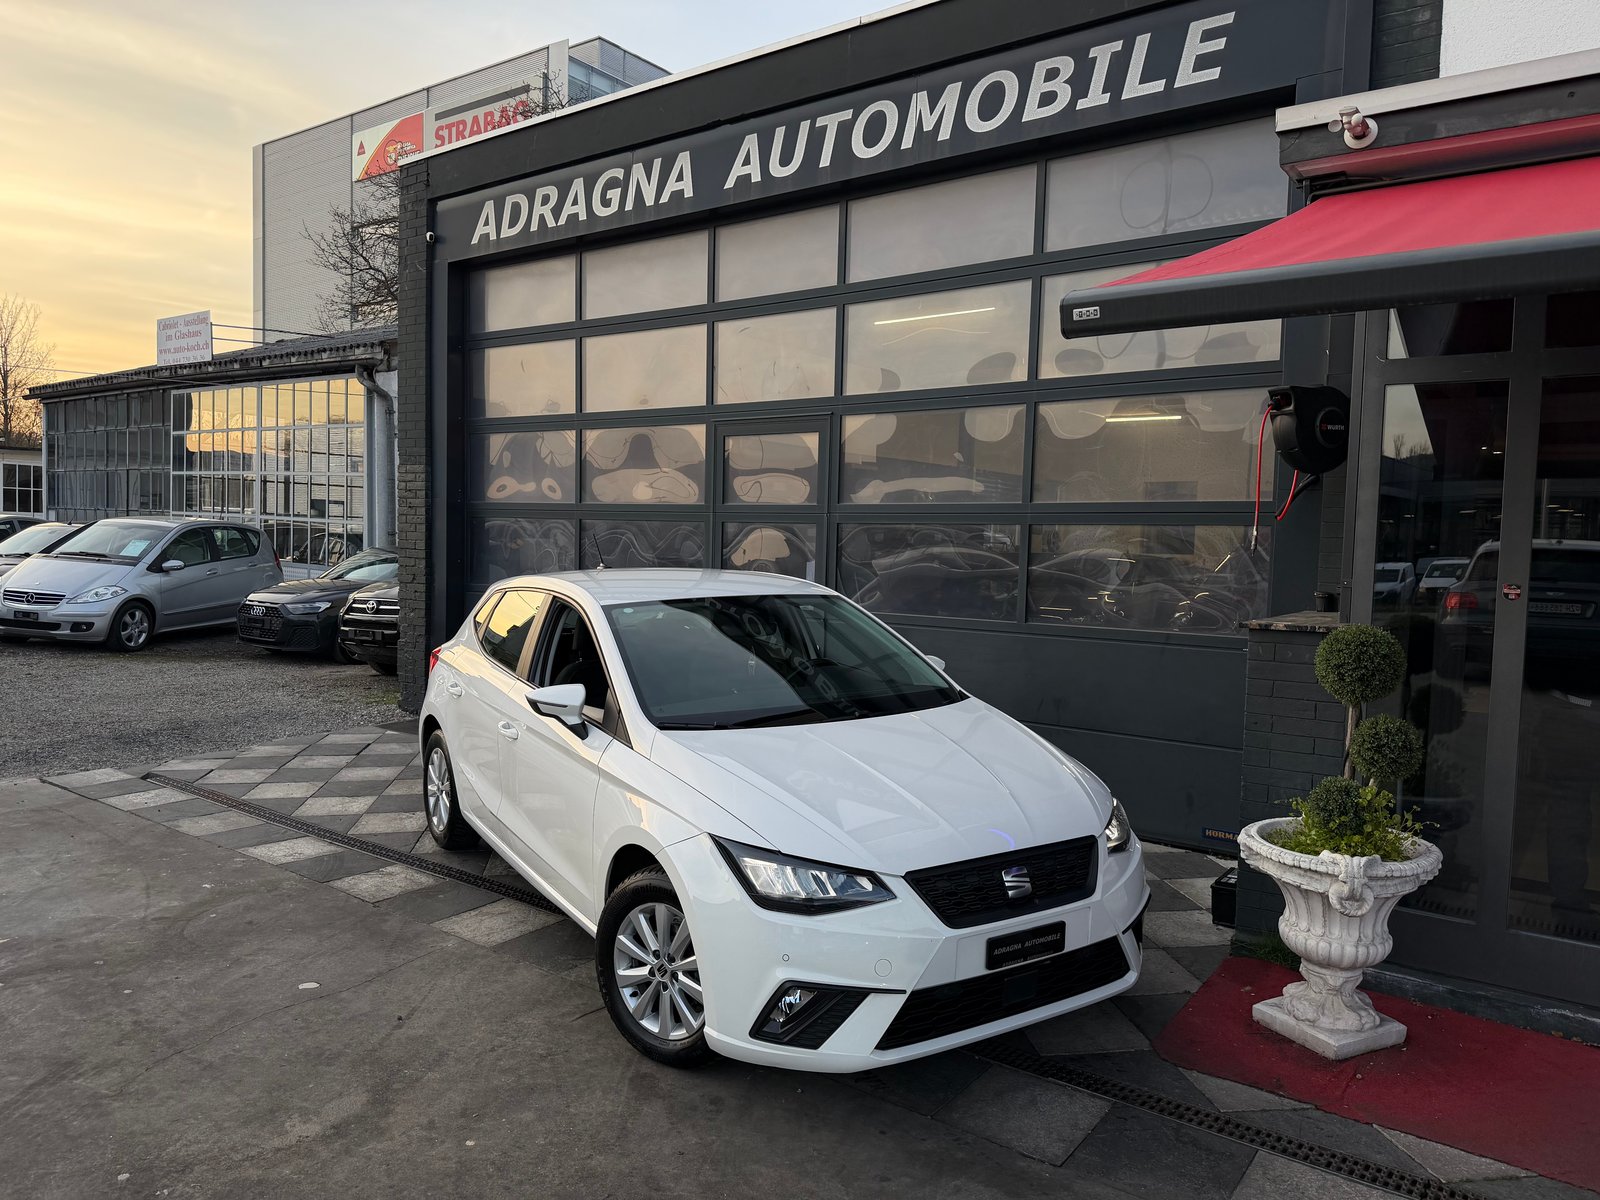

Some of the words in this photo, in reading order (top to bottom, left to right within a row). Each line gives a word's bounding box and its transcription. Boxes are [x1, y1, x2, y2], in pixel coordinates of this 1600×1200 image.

[470, 150, 694, 245] ADRAGNA
[723, 11, 1236, 189] AUTOMOBILE
[165, 332, 173, 341] im
[174, 329, 202, 341] Glashaus
[158, 340, 210, 355] www.auto-koch.ch
[993, 943, 1022, 955] ADRAGNA
[1024, 932, 1061, 948] AUTOMOBILE
